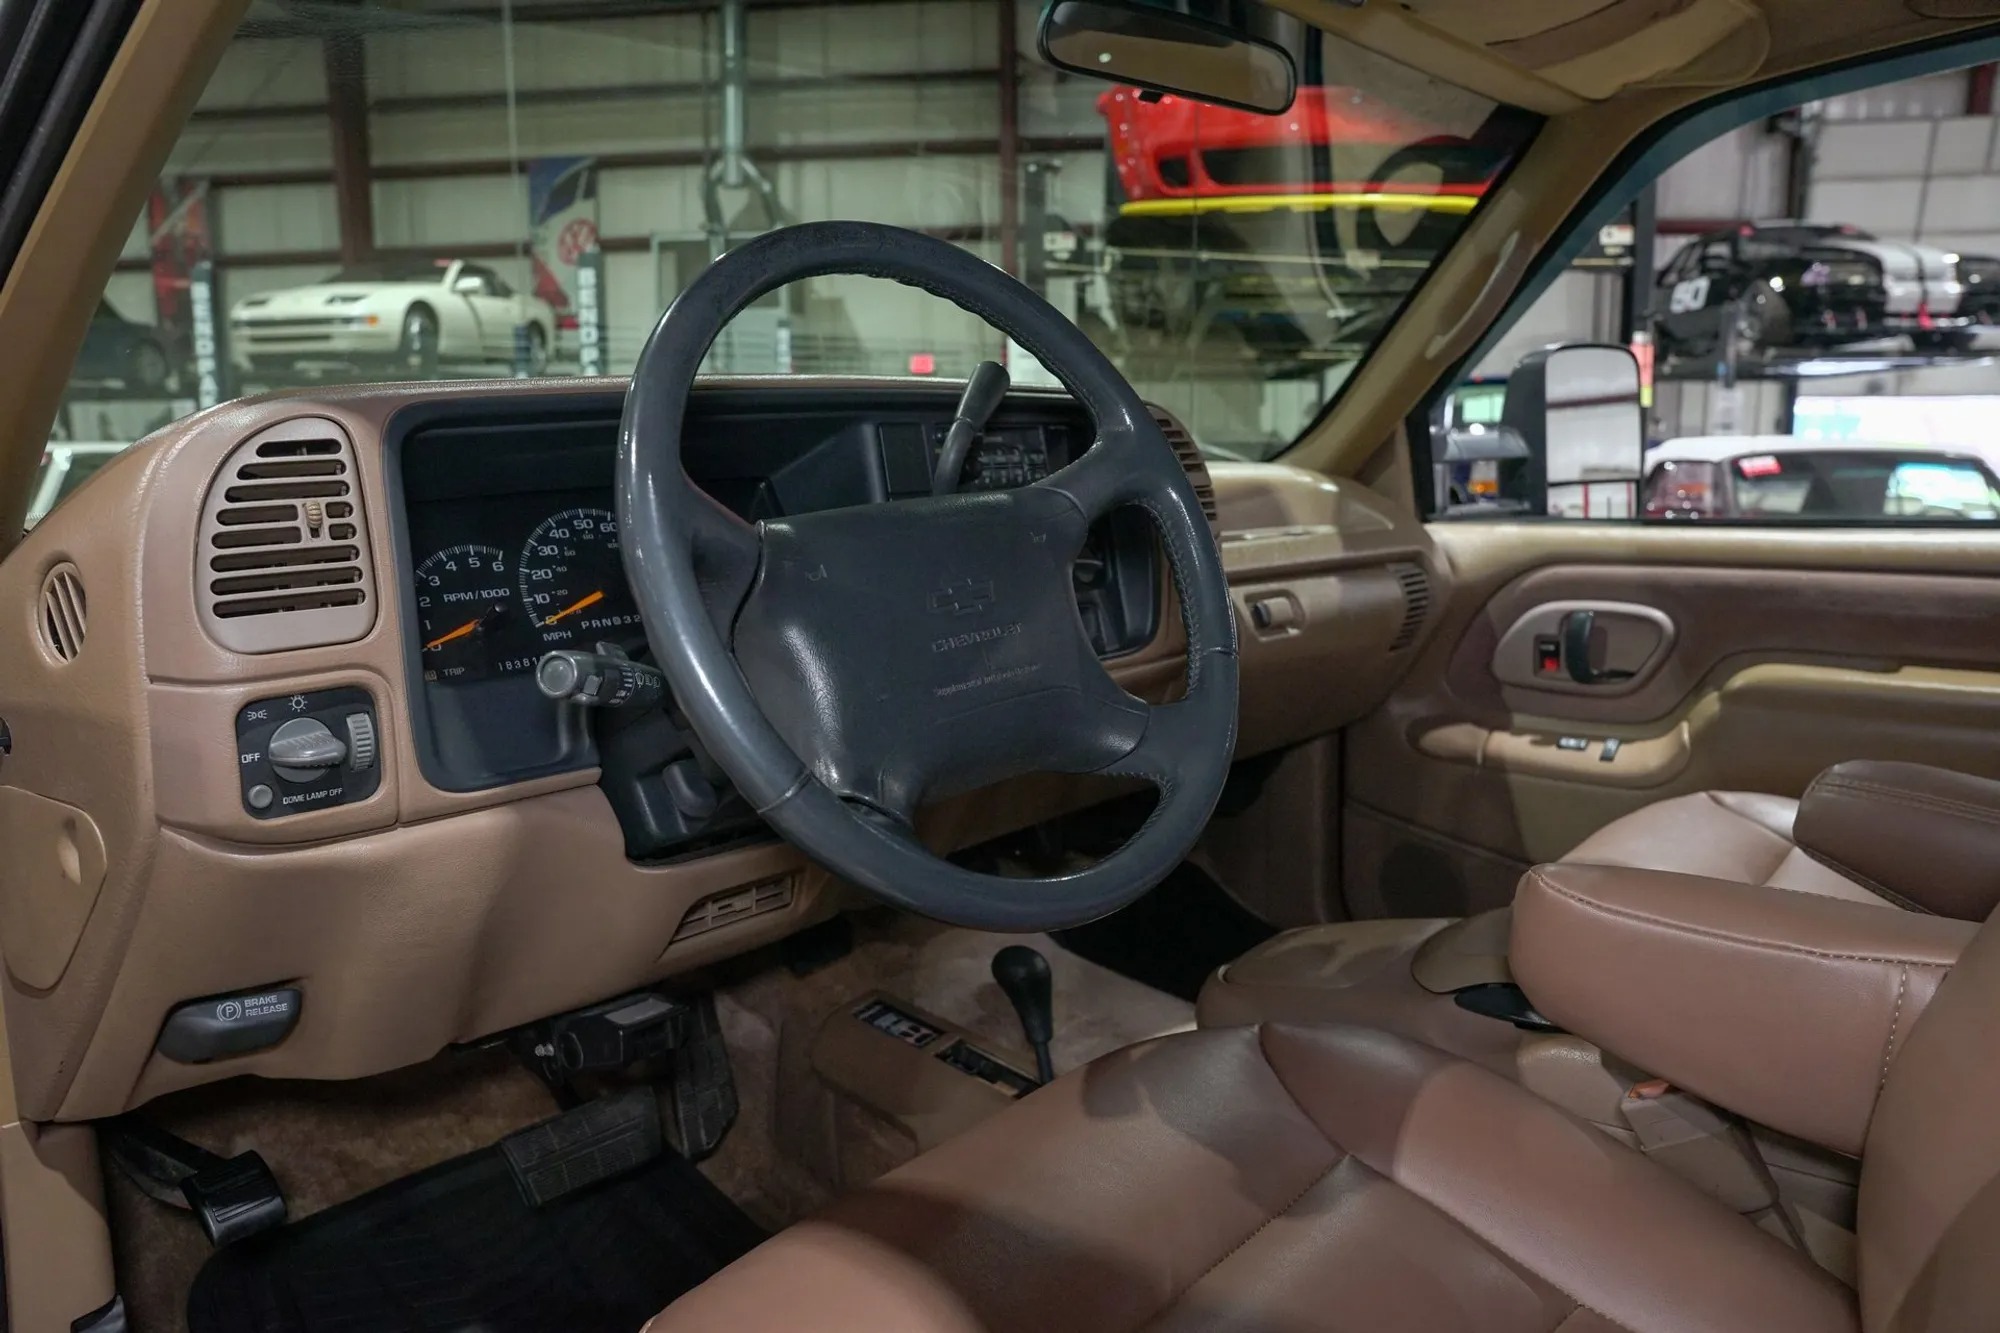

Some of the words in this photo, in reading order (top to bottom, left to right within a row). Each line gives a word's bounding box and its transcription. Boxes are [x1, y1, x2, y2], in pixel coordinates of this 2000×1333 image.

[573, 518, 594, 530] 50
[600, 521, 618, 533] 60
[549, 528, 570, 539] 40
[537, 545, 559, 556] 30
[445, 561, 458, 572] 4
[468, 557, 481, 568] 5
[492, 561, 505, 572] 6
[531, 568, 553, 580] 20
[428, 575, 441, 587] 3
[443, 588, 510, 603] RPM/1000
[533, 593, 550, 605] 10
[419, 596, 432, 608] 2
[424, 619, 432, 631] 1
[543, 630, 572, 641] MPH
[498, 656, 546, 672] 18381
[443, 666, 466, 677] TRIP
[241, 752, 262, 764] OFF
[282, 794, 305, 805] DOME
[306, 789, 328, 801] LAMP
[329, 787, 343, 797] OFF
[244, 995, 278, 1008] BRAKE
[245, 1003, 289, 1017] RELEASE
